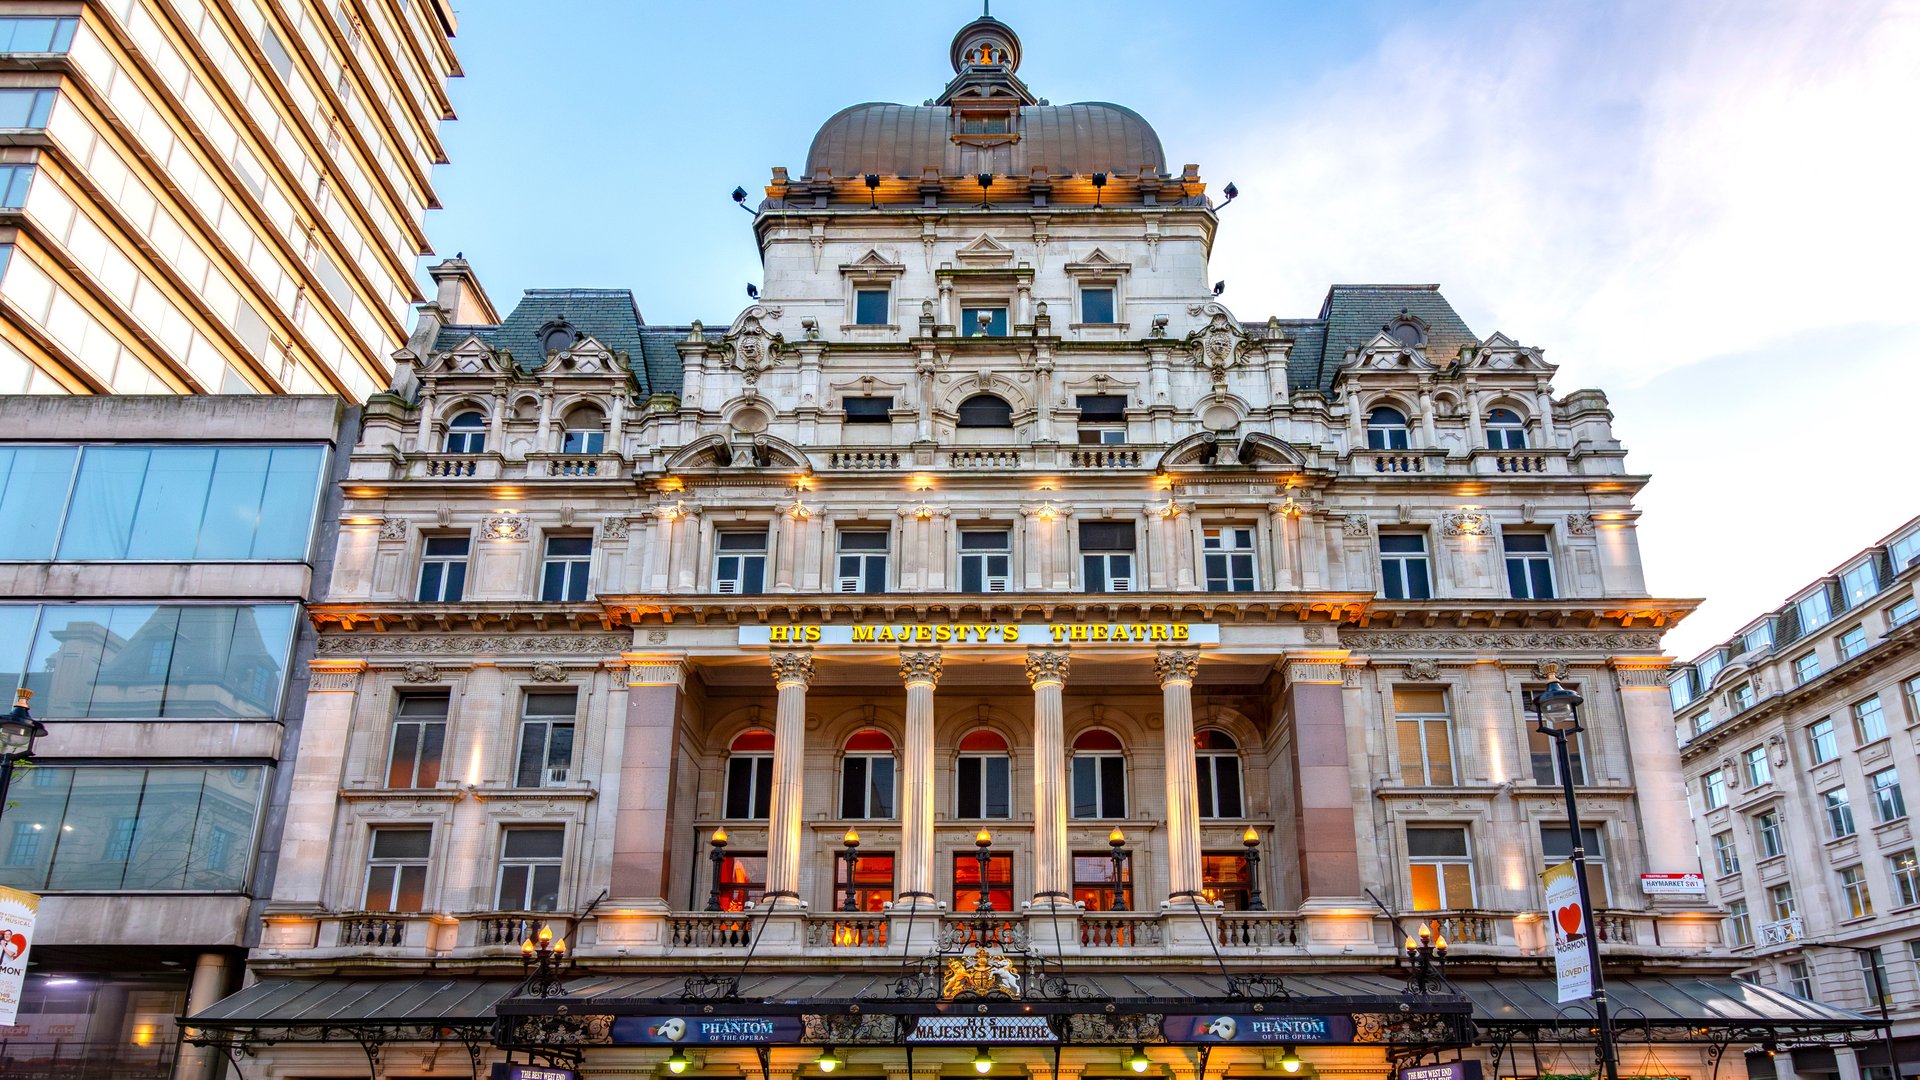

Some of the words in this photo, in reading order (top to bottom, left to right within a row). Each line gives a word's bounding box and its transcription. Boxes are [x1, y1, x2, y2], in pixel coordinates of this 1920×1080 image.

[769, 625, 822, 642] HIS
[852, 624, 1019, 642] MAJESTY'S
[1050, 623, 1190, 642] THEATRE
[5, 917, 31, 928] MUSICAL
[1557, 939, 1586, 954] MORMON
[1562, 966, 1583, 978] LOVED
[701, 1021, 774, 1034] PHANTOM
[967, 1017, 996, 1026] HIS
[1252, 1020, 1325, 1033] PHANTOM
[915, 1026, 986, 1039] MAJESTYS
[990, 1025, 1050, 1039] THEATRE
[521, 1070, 532, 1079] THE
[531, 1071, 543, 1080] BEST
[543, 1072, 556, 1080] WEST
[1407, 1071, 1417, 1080] THE
[1417, 1070, 1428, 1079] BEST
[1428, 1068, 1441, 1078] WEST
[1441, 1067, 1452, 1077] END
